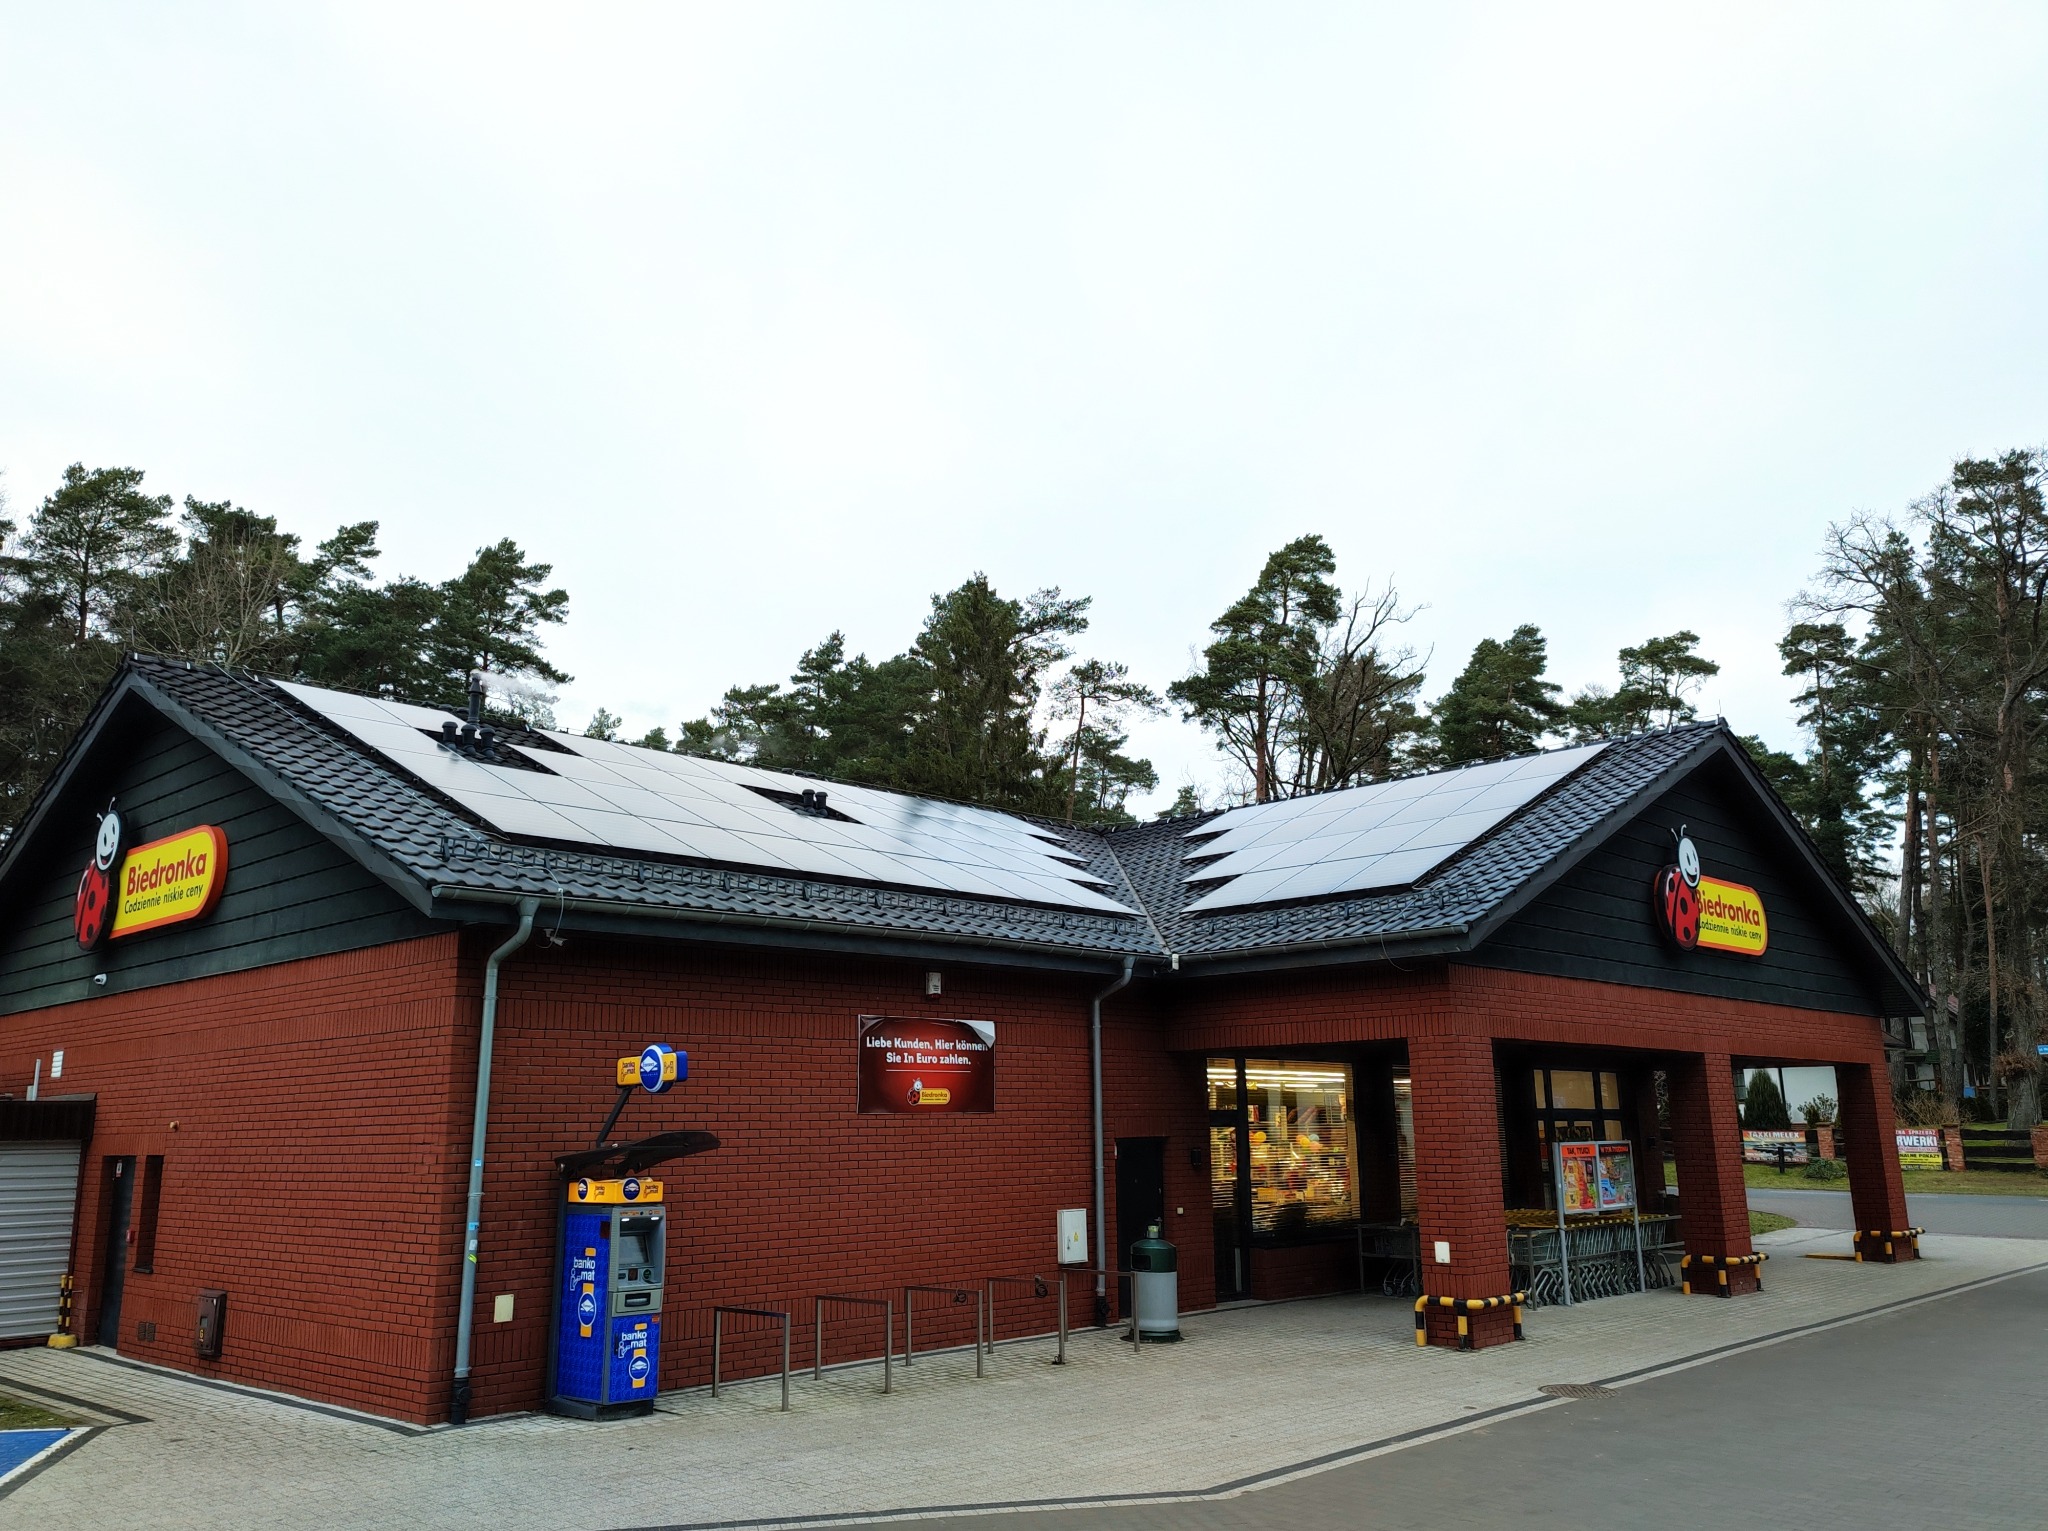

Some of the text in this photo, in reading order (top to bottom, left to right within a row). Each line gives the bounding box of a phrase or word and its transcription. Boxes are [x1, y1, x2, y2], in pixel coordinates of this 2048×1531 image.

[126, 849, 208, 896] Biedronka
[124, 883, 203, 914] Codziennie niskie ceny
[1731, 923, 1748, 937] niskie
[866, 1036, 988, 1052] Liebe Kunden, Hier können
[886, 1052, 971, 1065] Sie In Euro zahlen.
[1896, 1136, 1938, 1147] RWERKI
[573, 1256, 596, 1269] banko
[580, 1270, 595, 1281] mat
[621, 1330, 648, 1341] banko
[630, 1339, 647, 1348] mat
